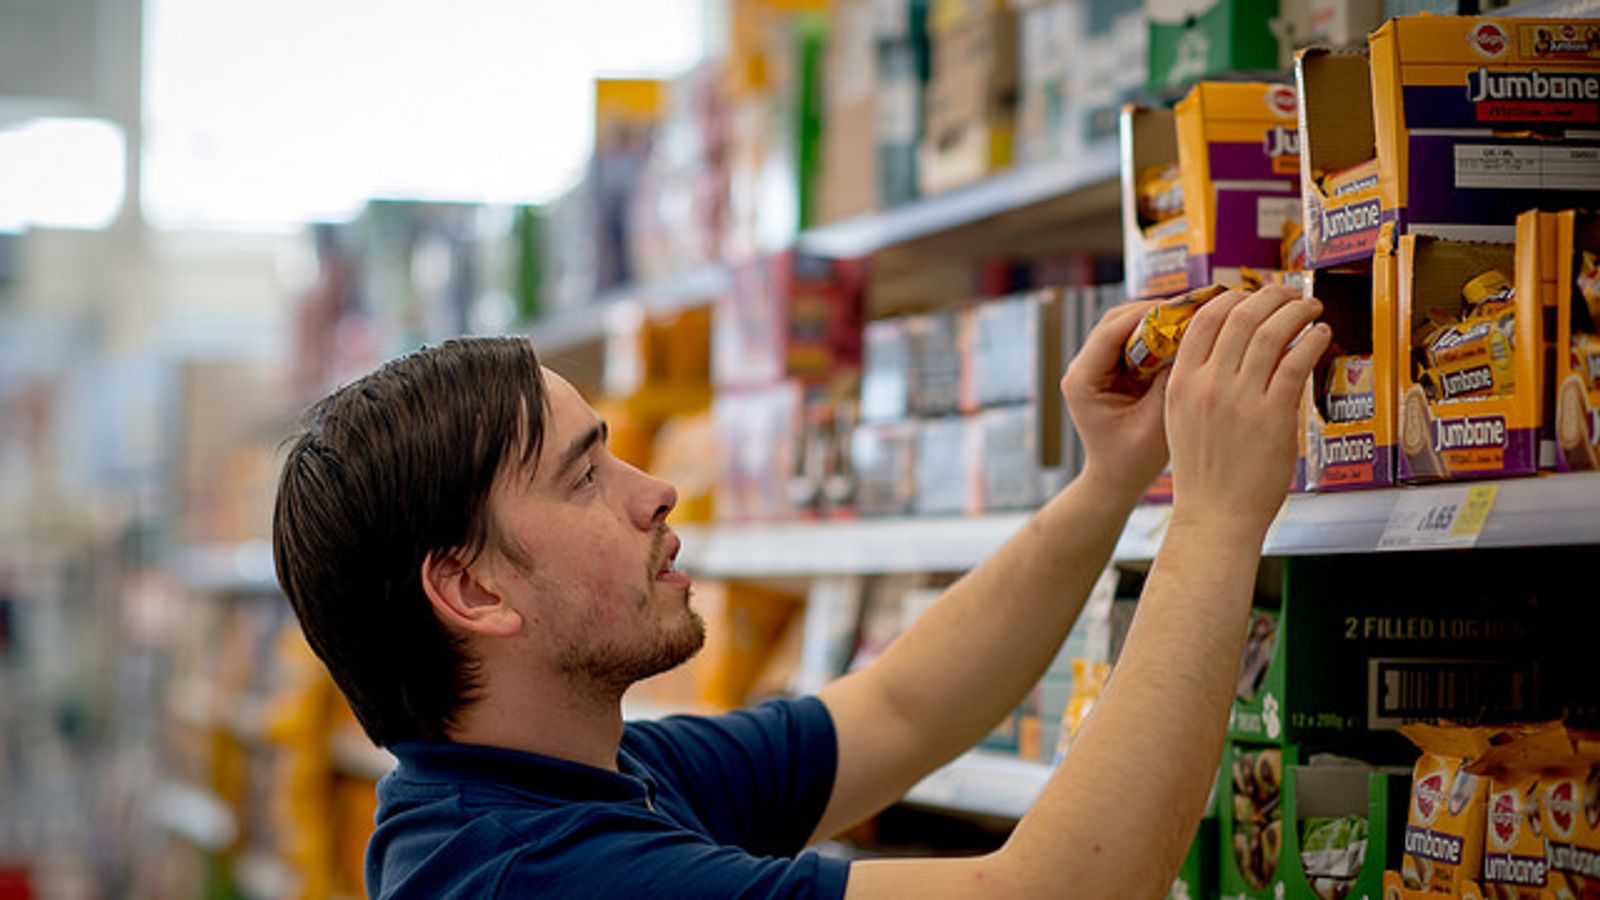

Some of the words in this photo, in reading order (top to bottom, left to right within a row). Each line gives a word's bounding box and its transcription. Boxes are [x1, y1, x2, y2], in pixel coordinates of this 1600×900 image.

[1472, 67, 1600, 102] Jumbone
[1322, 203, 1380, 242] Jumbone
[1442, 367, 1493, 398] Jumbone
[1435, 416, 1505, 452] Jumbone
[1320, 435, 1374, 468] Jumbone
[1344, 616, 1359, 639] 2
[1364, 617, 1435, 639] FILLED
[1405, 830, 1460, 863] umbone
[1545, 837, 1600, 879] Jumbon
[1485, 854, 1546, 884] umbone
